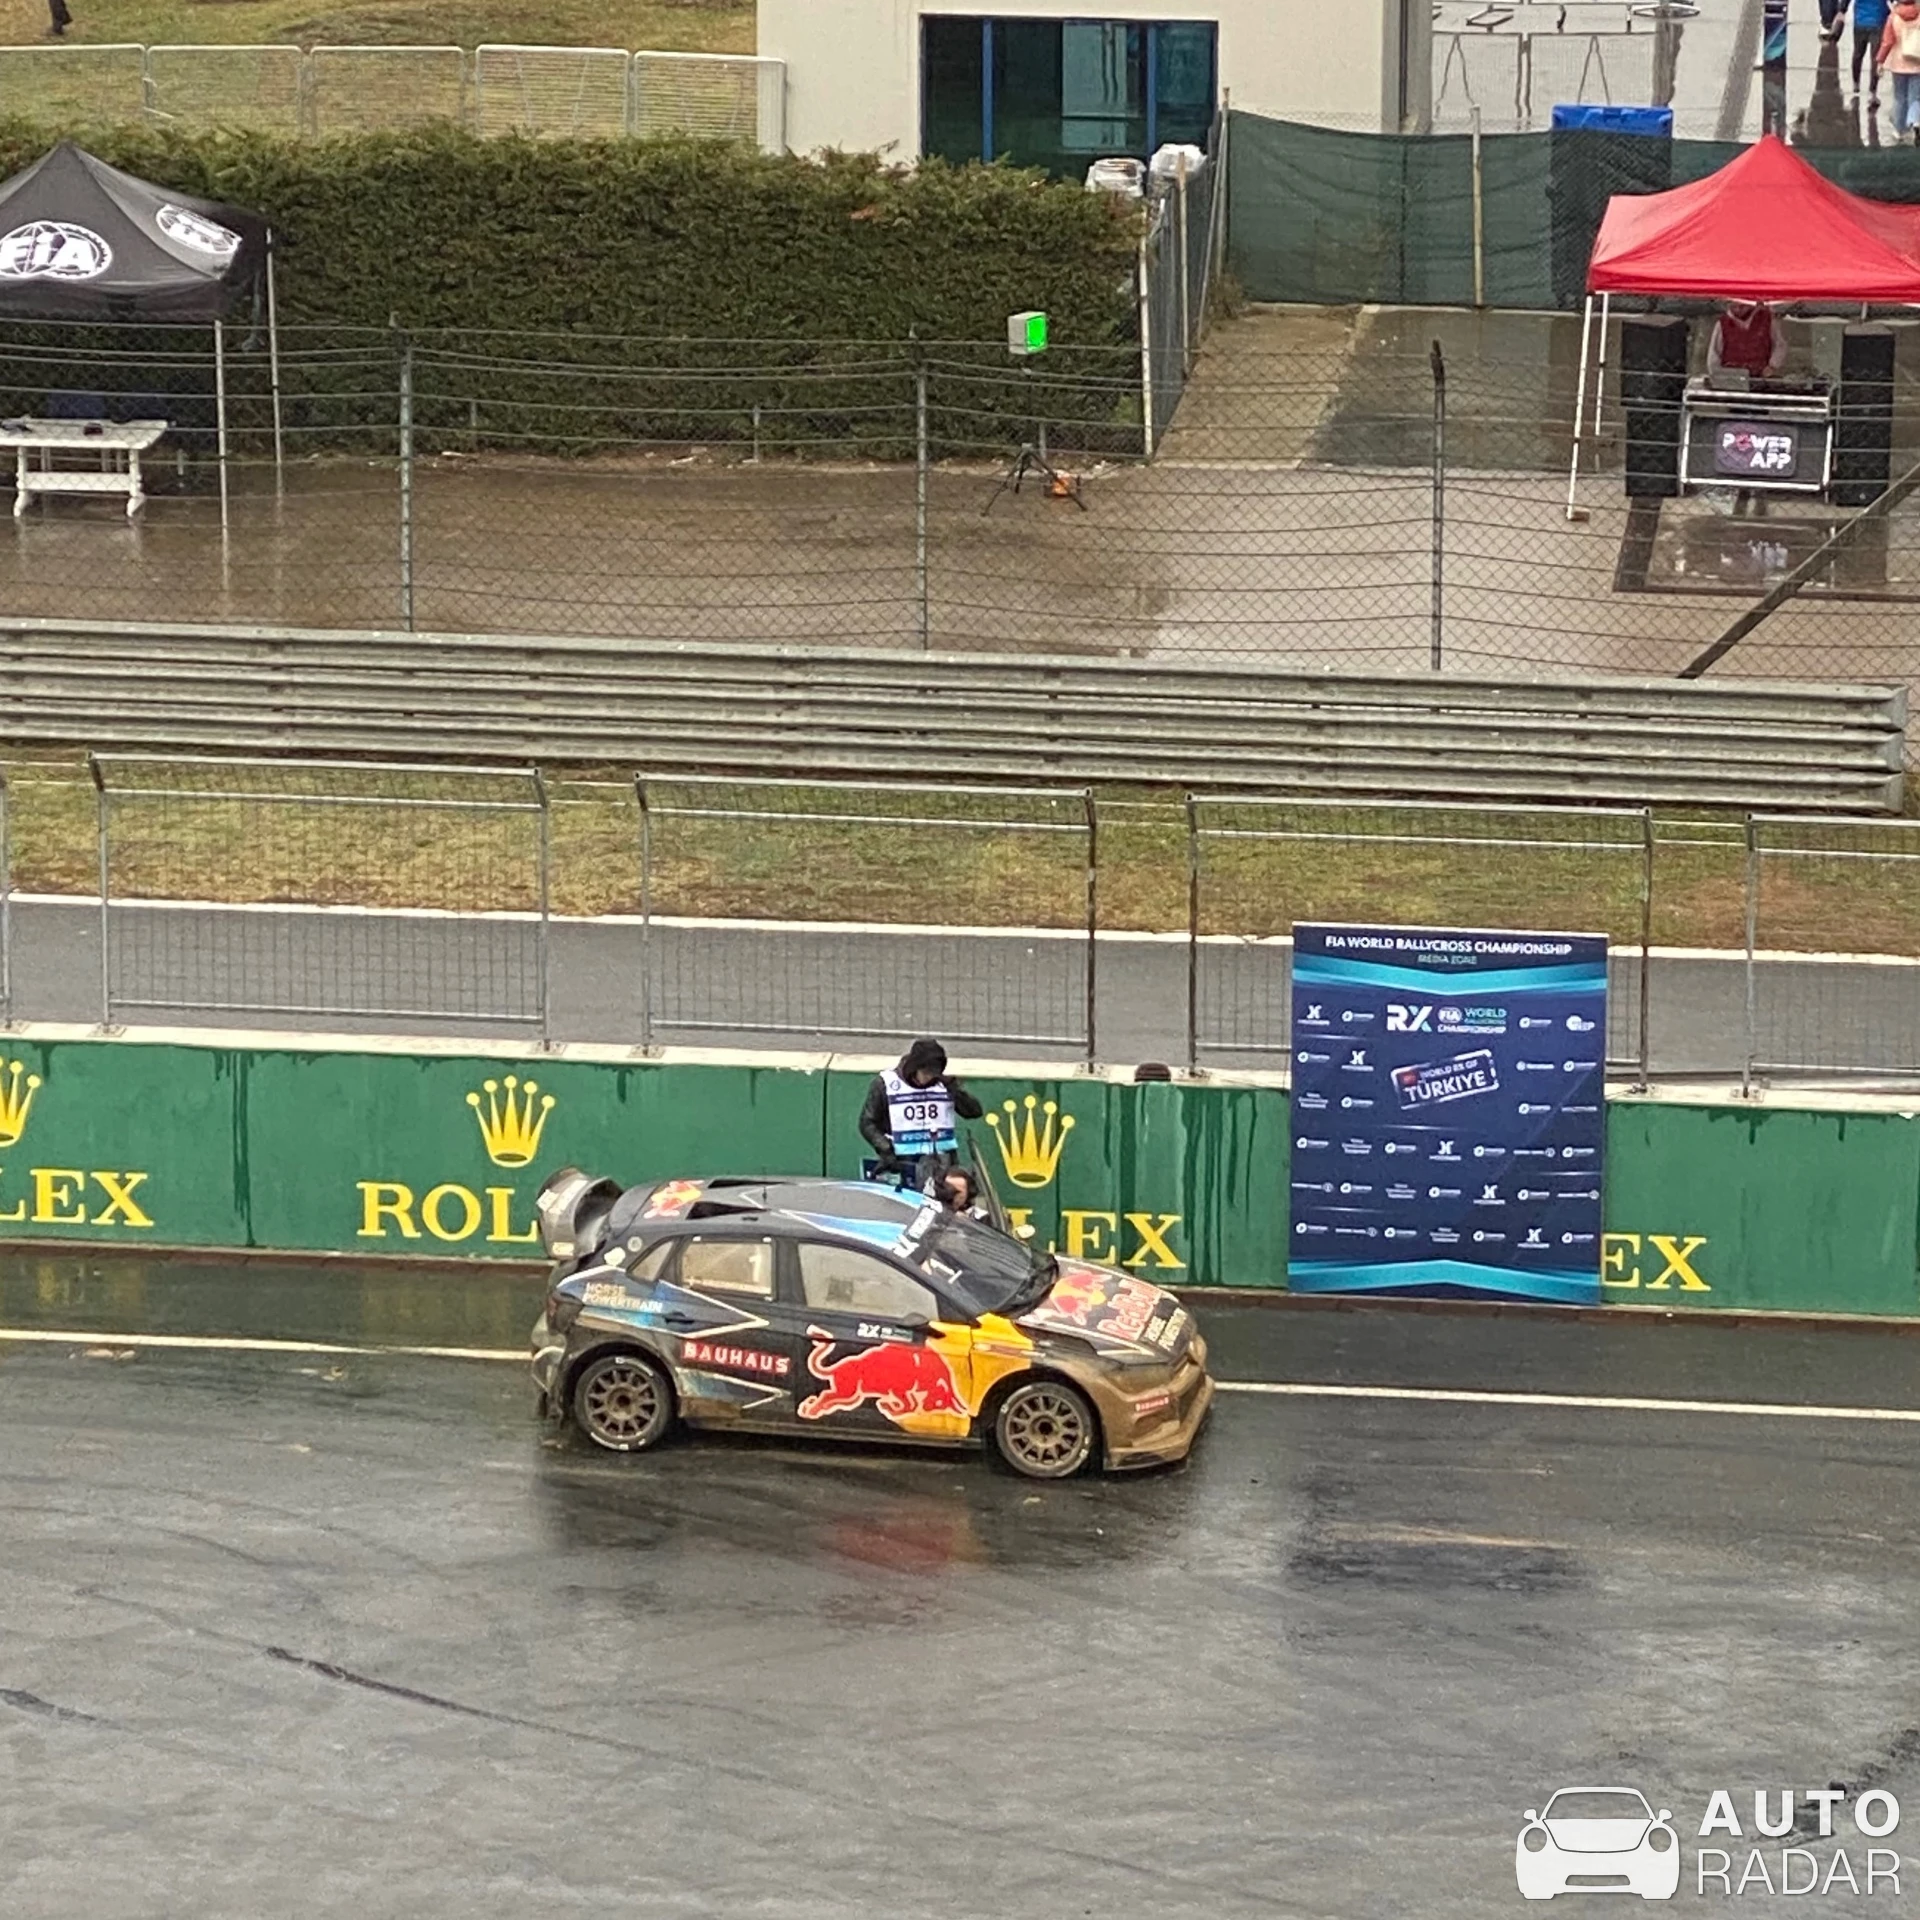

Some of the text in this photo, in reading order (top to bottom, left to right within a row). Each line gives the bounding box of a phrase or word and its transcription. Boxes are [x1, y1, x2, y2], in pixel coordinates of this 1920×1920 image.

[0, 232, 95, 270] FIA
[1750, 452, 1791, 469] APP
[1326, 936, 1572, 955] FIA WORLD RALLYCROSS CHAMPIONSHIP
[1387, 1004, 1432, 1032] RX
[1464, 1007, 1507, 1018] WORLD
[903, 1104, 938, 1121] 038
[684, 1341, 791, 1373] BAUHAUS
